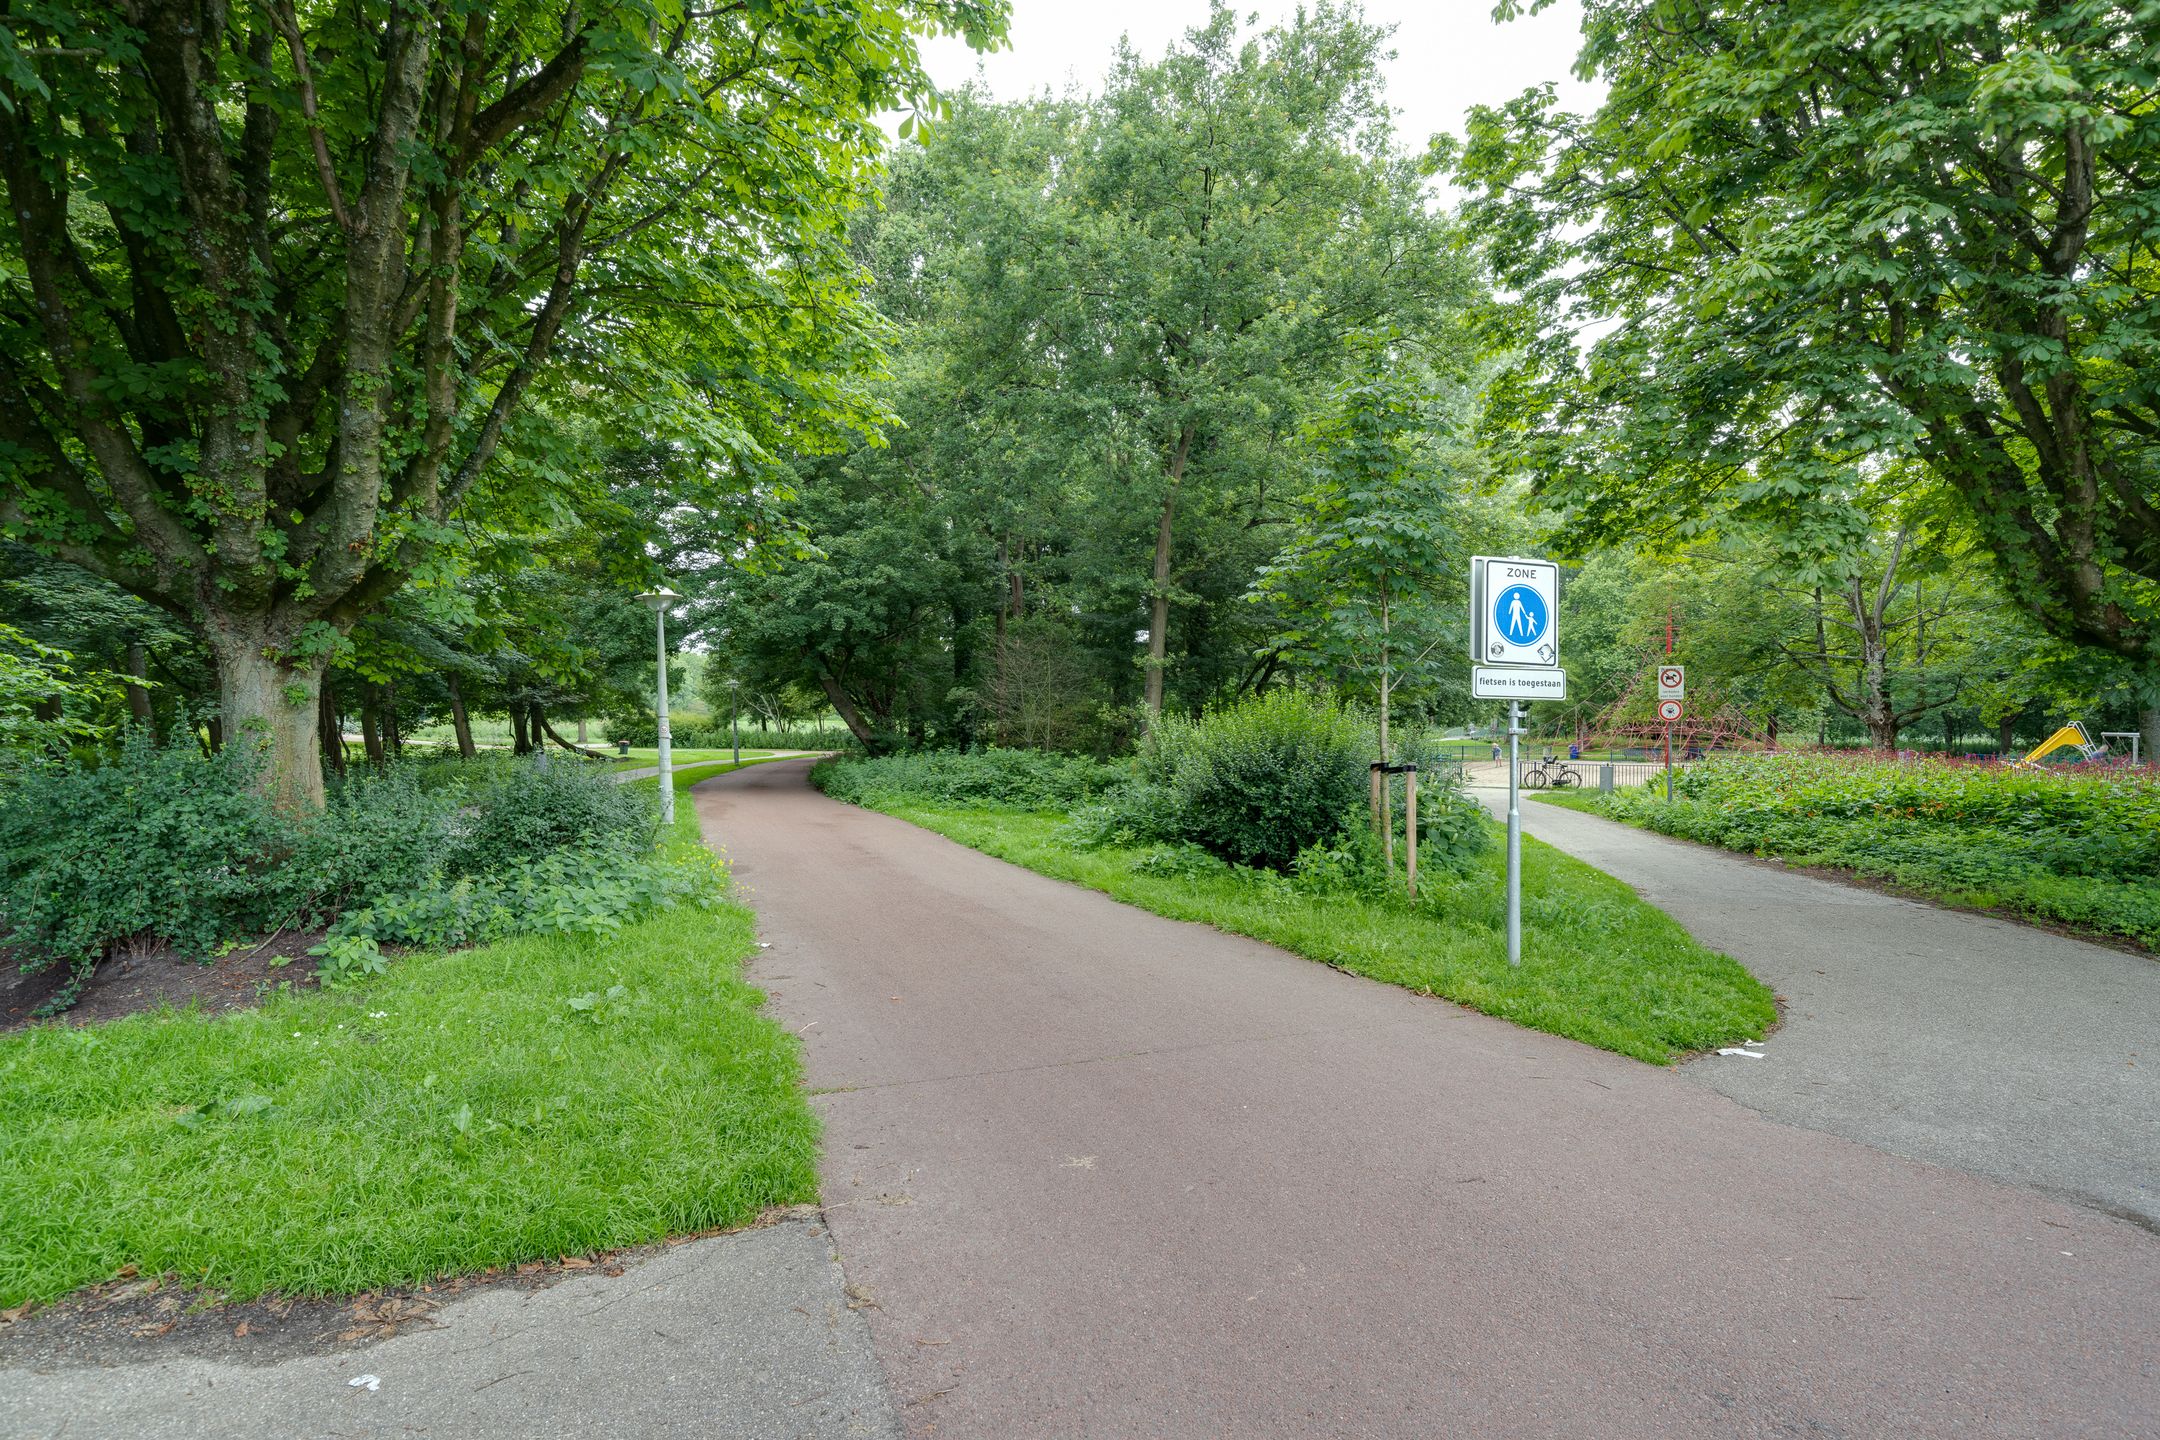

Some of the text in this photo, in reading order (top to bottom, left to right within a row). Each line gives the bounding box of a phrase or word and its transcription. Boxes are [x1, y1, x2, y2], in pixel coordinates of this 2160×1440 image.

[1507, 568, 1537, 579] ZONE
[1479, 677, 1561, 689] fietsen is toegestaan
